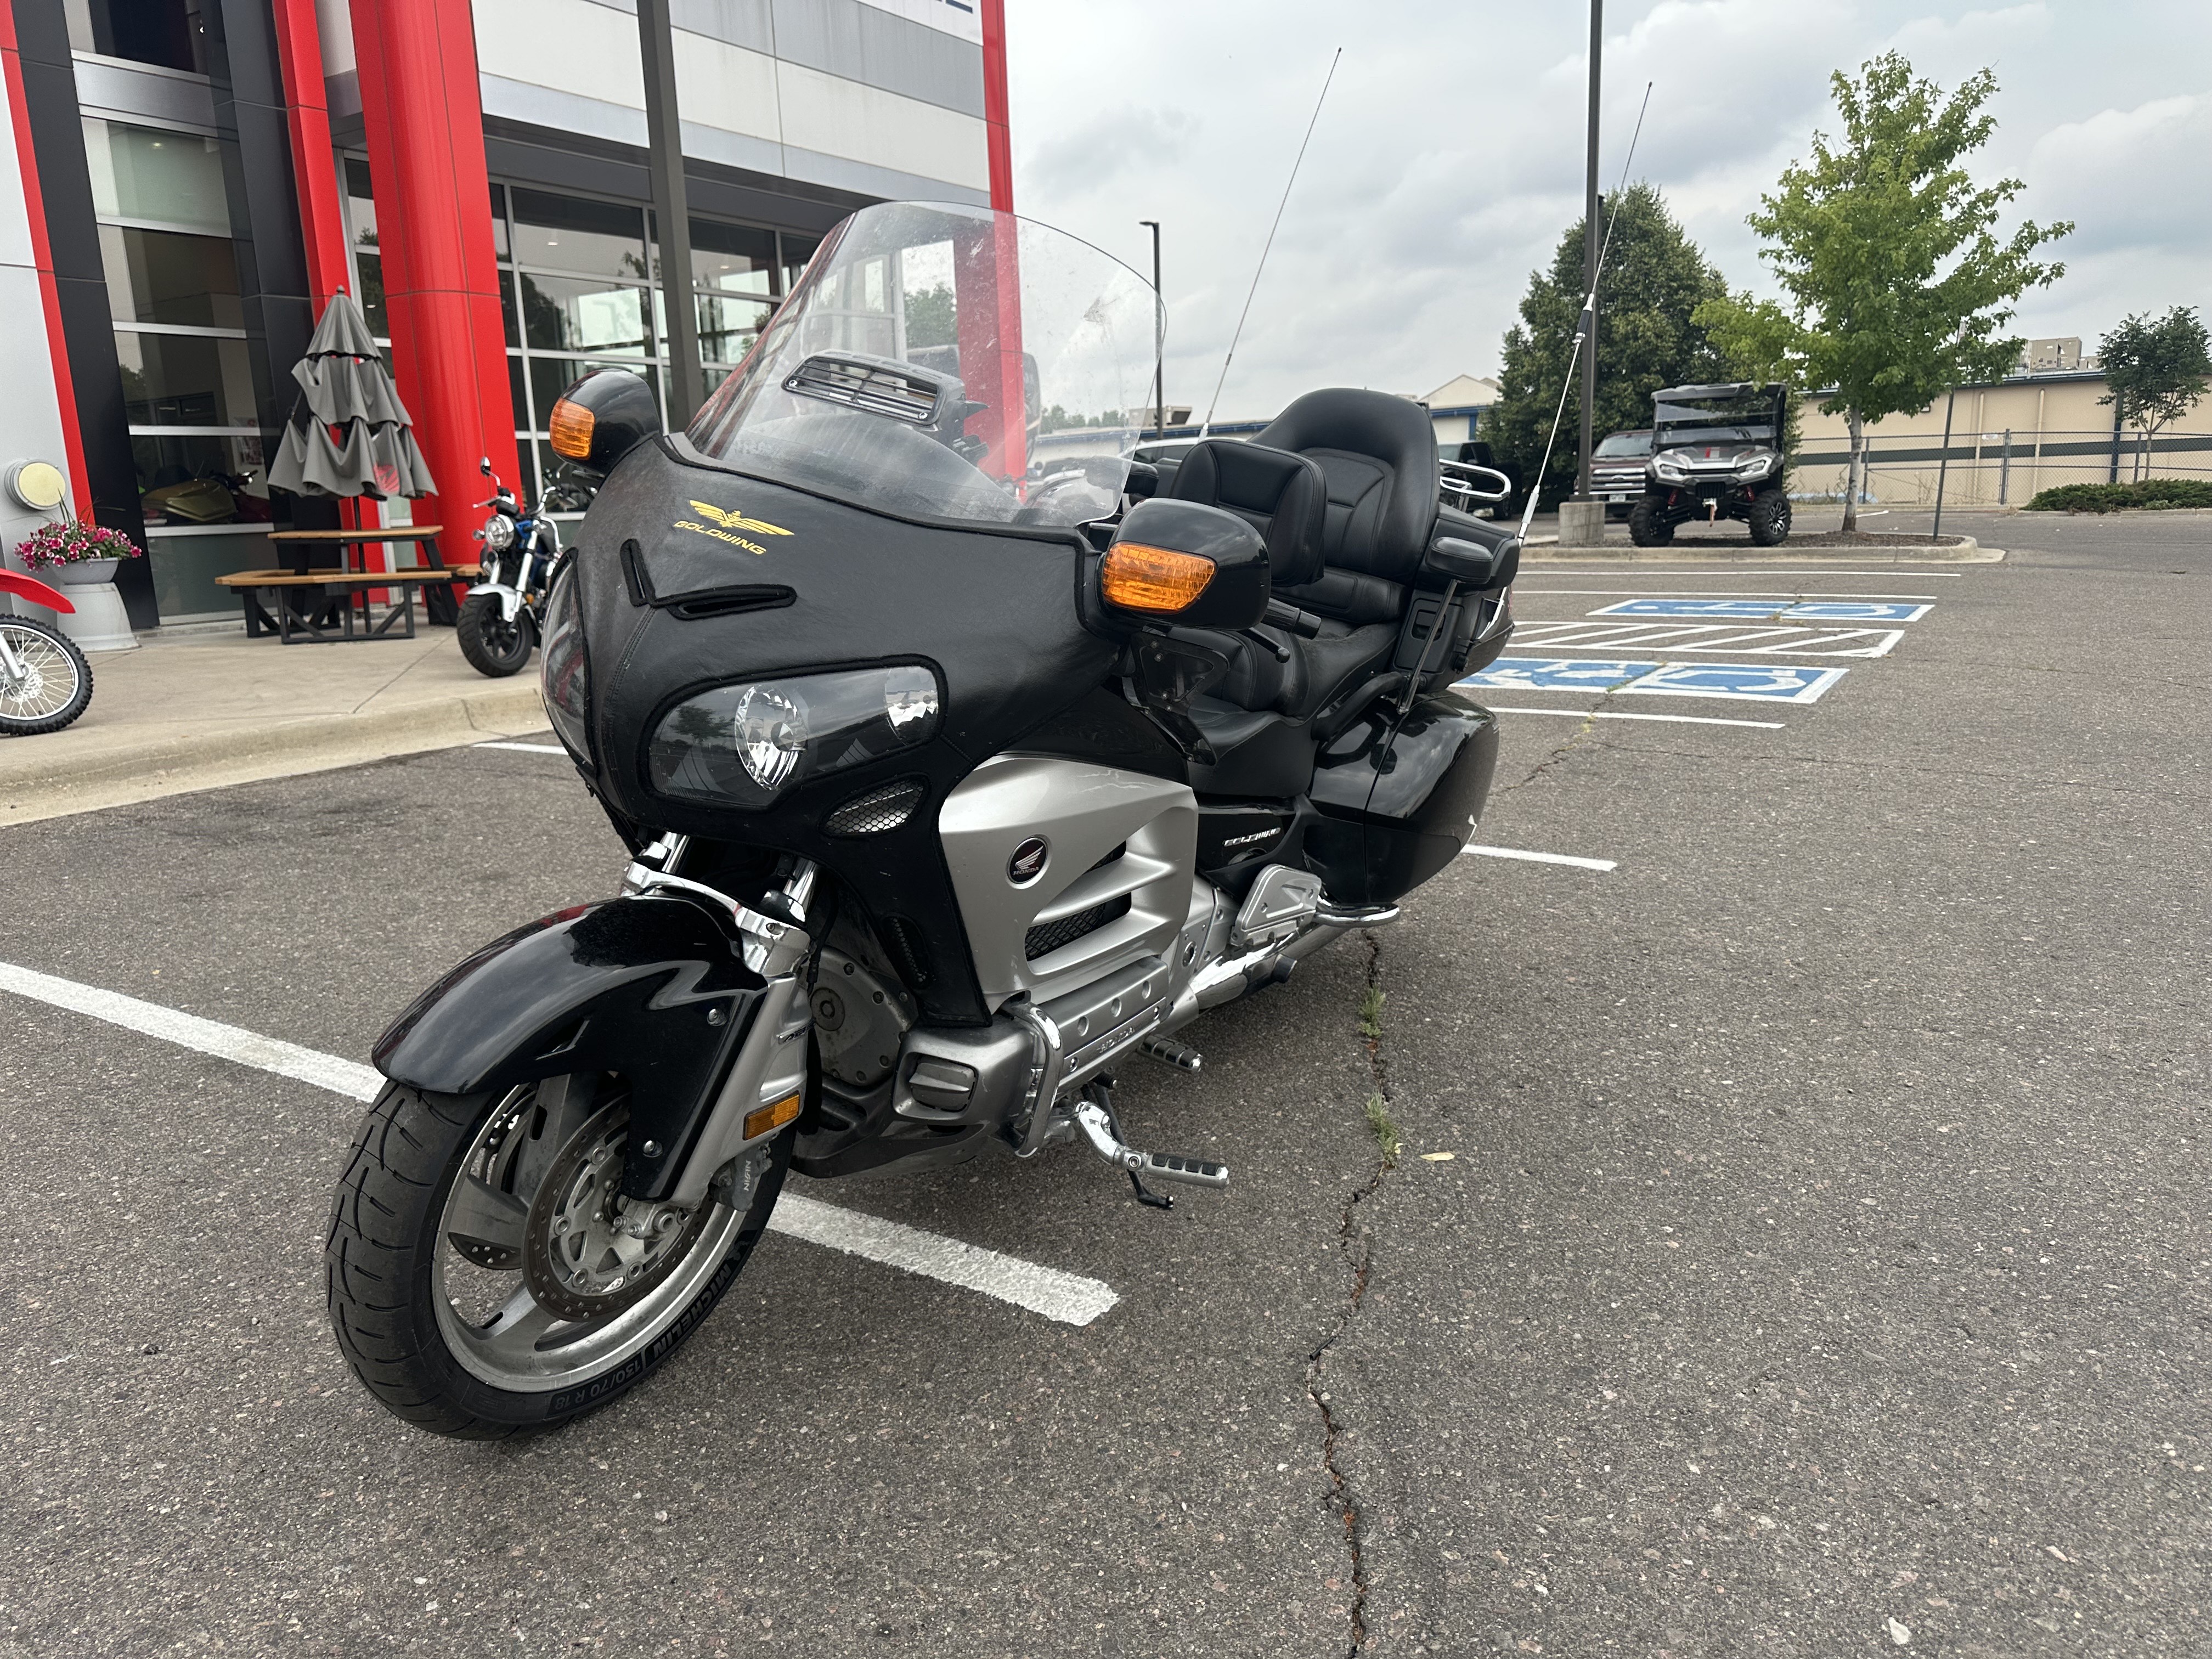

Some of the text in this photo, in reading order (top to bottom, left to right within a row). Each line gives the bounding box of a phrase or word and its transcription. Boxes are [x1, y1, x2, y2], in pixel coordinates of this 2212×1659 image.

[673, 520, 767, 555] GOLDWING
[1013, 866, 1040, 876] HONDA
[743, 1160, 752, 1192] NISSIN
[653, 1263, 732, 1359] MICHELIN
[590, 1360, 641, 1397] 130/70
[555, 1395, 571, 1410] 18
[574, 1390, 585, 1403] R
